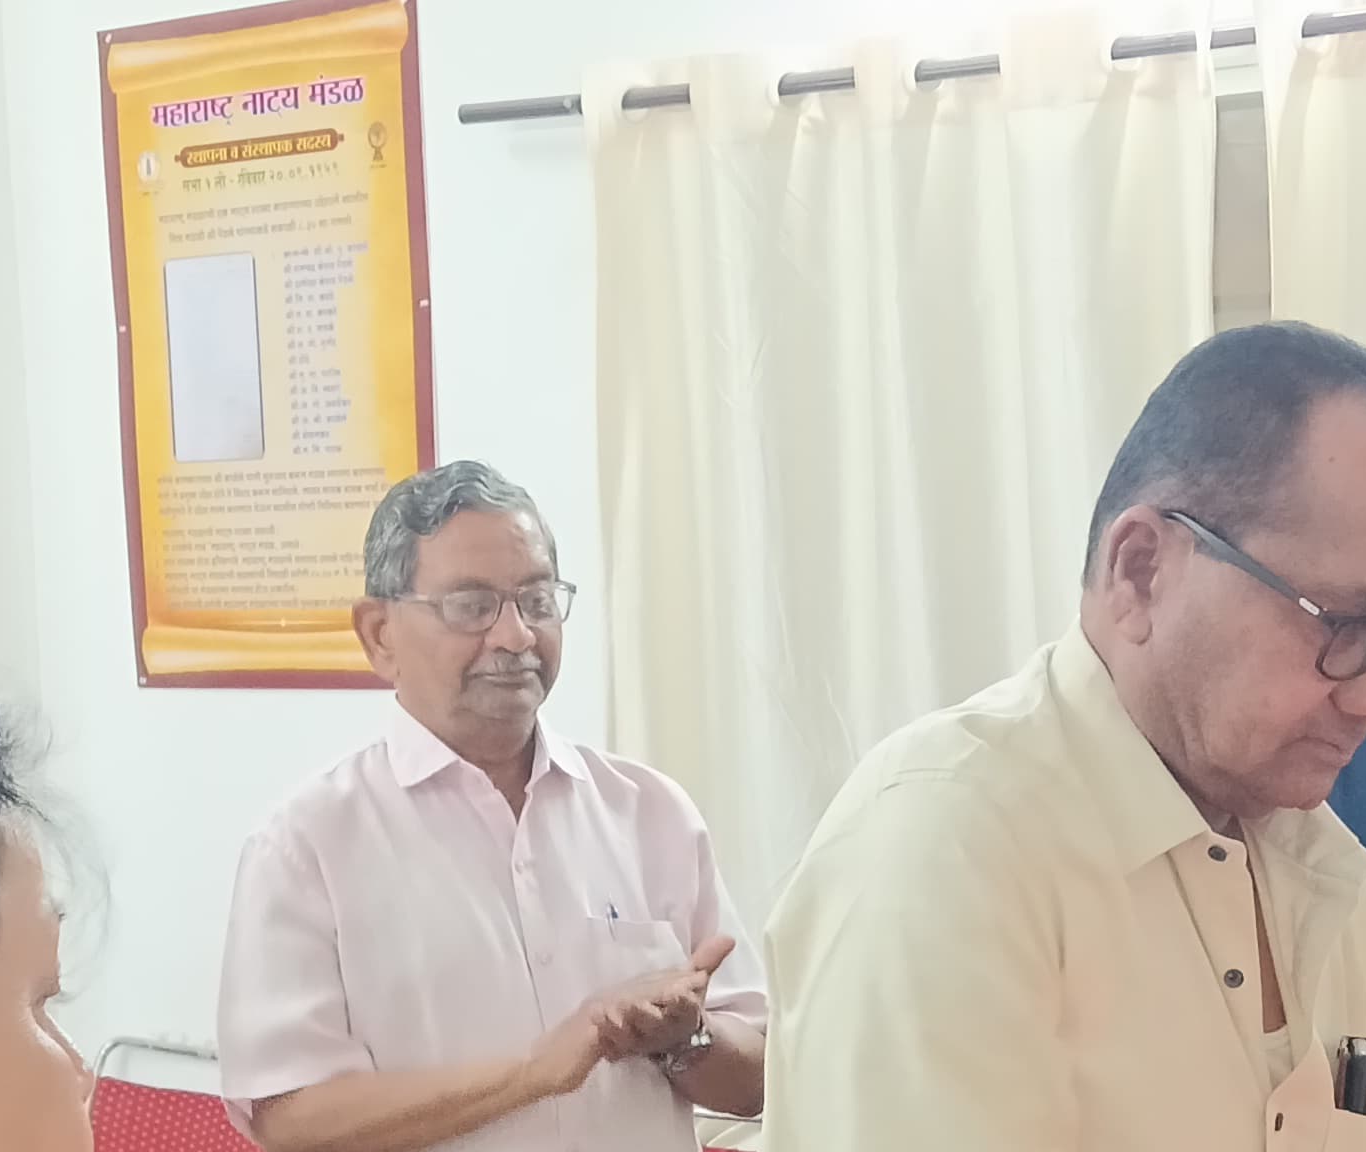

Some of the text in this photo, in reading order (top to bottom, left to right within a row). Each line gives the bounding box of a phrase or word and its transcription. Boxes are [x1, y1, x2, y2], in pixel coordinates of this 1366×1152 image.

[241, 86, 299, 116] नाट्य
[309, 75, 363, 106] मंडळ
[185, 146, 227, 166] स्थापना
[242, 137, 294, 159] संस्थापक
[296, 134, 332, 151] सदस्य
